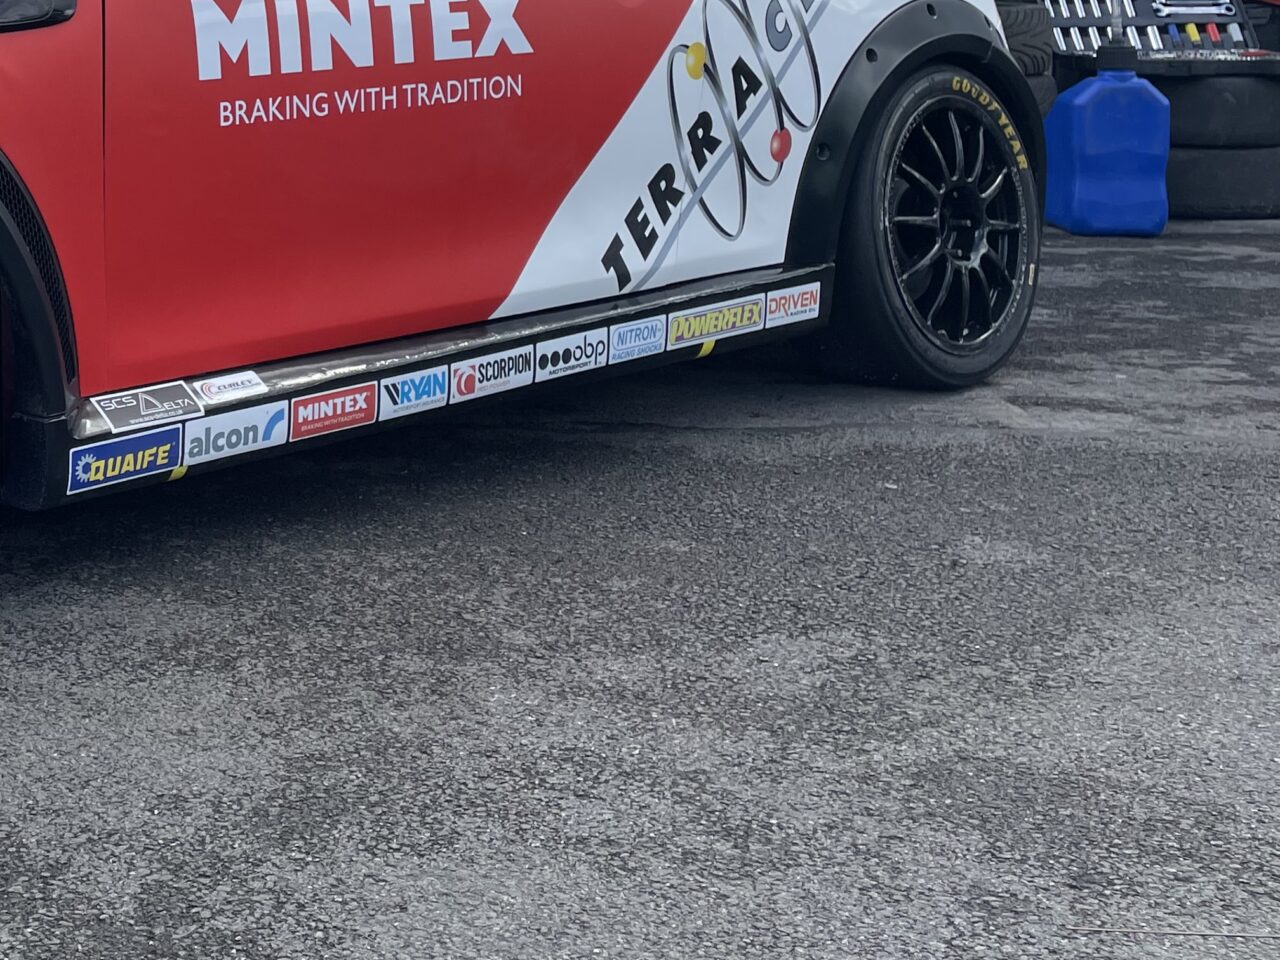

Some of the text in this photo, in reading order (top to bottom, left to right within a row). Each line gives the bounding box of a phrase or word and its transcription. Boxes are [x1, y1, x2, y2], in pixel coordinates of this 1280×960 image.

[219, 74, 522, 127] BRAKING WITH TRADITION
[769, 290, 818, 317] DRIVEN
[617, 324, 657, 346] NITRON
[672, 301, 761, 344] POWERFLEX
[478, 352, 532, 384] SCORPION
[549, 361, 592, 376] MOTORSPORT
[611, 349, 636, 361] RACING
[100, 396, 136, 411] SCS
[400, 372, 446, 404] RYAN
[298, 392, 368, 423] MINTEX
[188, 424, 259, 458] alcon
[89, 444, 171, 482] QUAIFE
